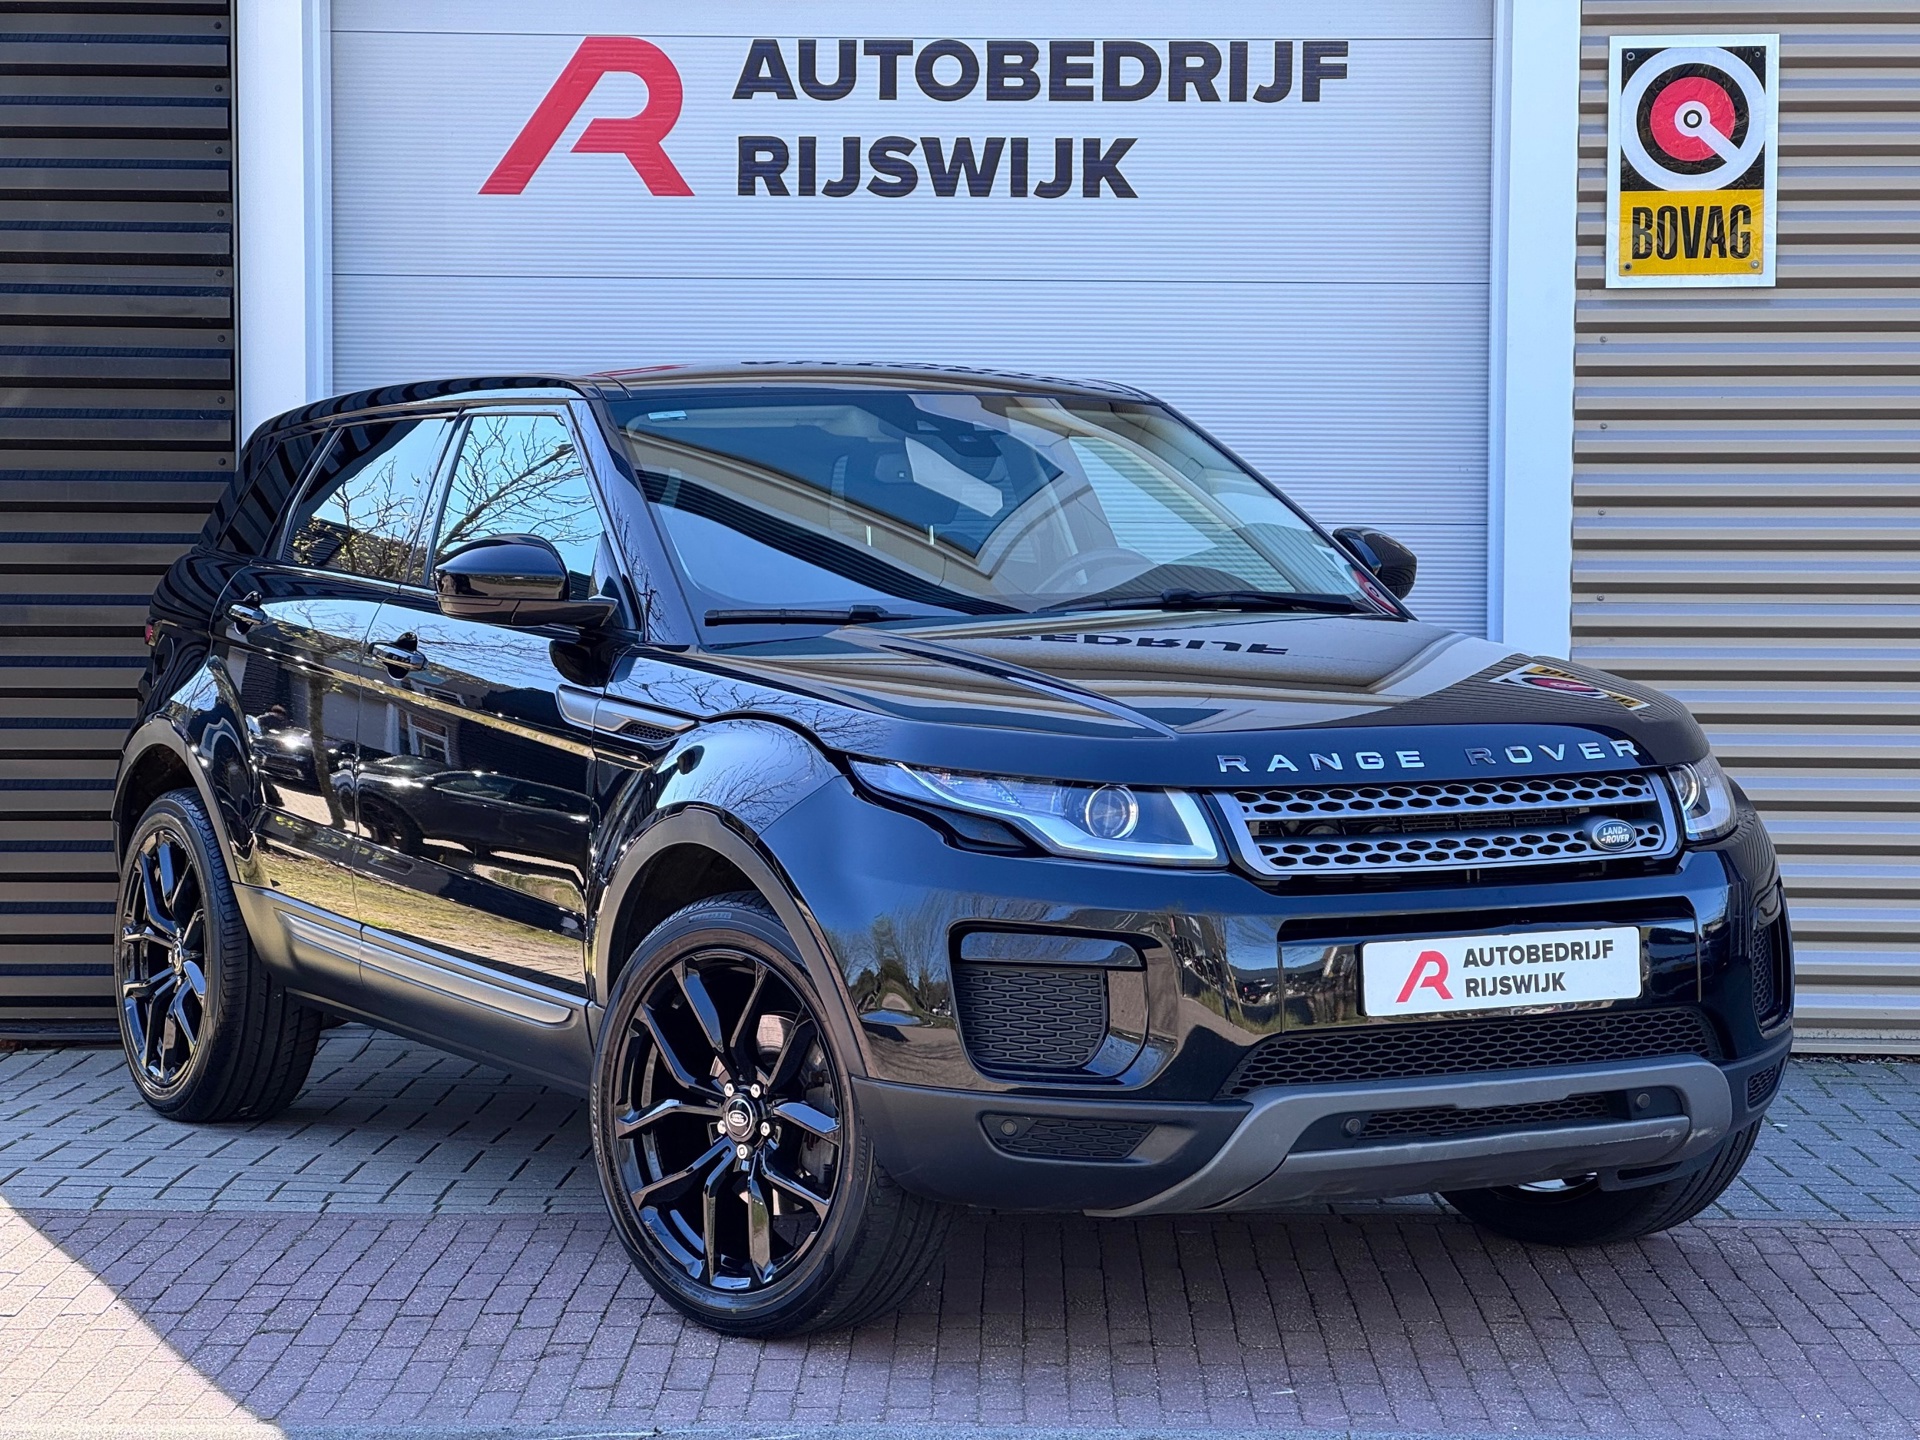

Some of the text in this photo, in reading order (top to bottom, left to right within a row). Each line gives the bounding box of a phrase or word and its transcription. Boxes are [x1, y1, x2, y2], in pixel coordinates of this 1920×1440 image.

[732, 38, 1350, 104] AUTOBEDRIJF
[736, 134, 1140, 199] RIJSWIJK
[1631, 203, 1753, 260] BOVAG
[1216, 738, 1641, 774] RANGE ROVER
[1602, 826, 1623, 836] LAND
[1605, 833, 1630, 844] ROVER
[1462, 939, 1614, 968] AUTOBEDRIJF
[1465, 972, 1567, 998] RIJSWIJK
